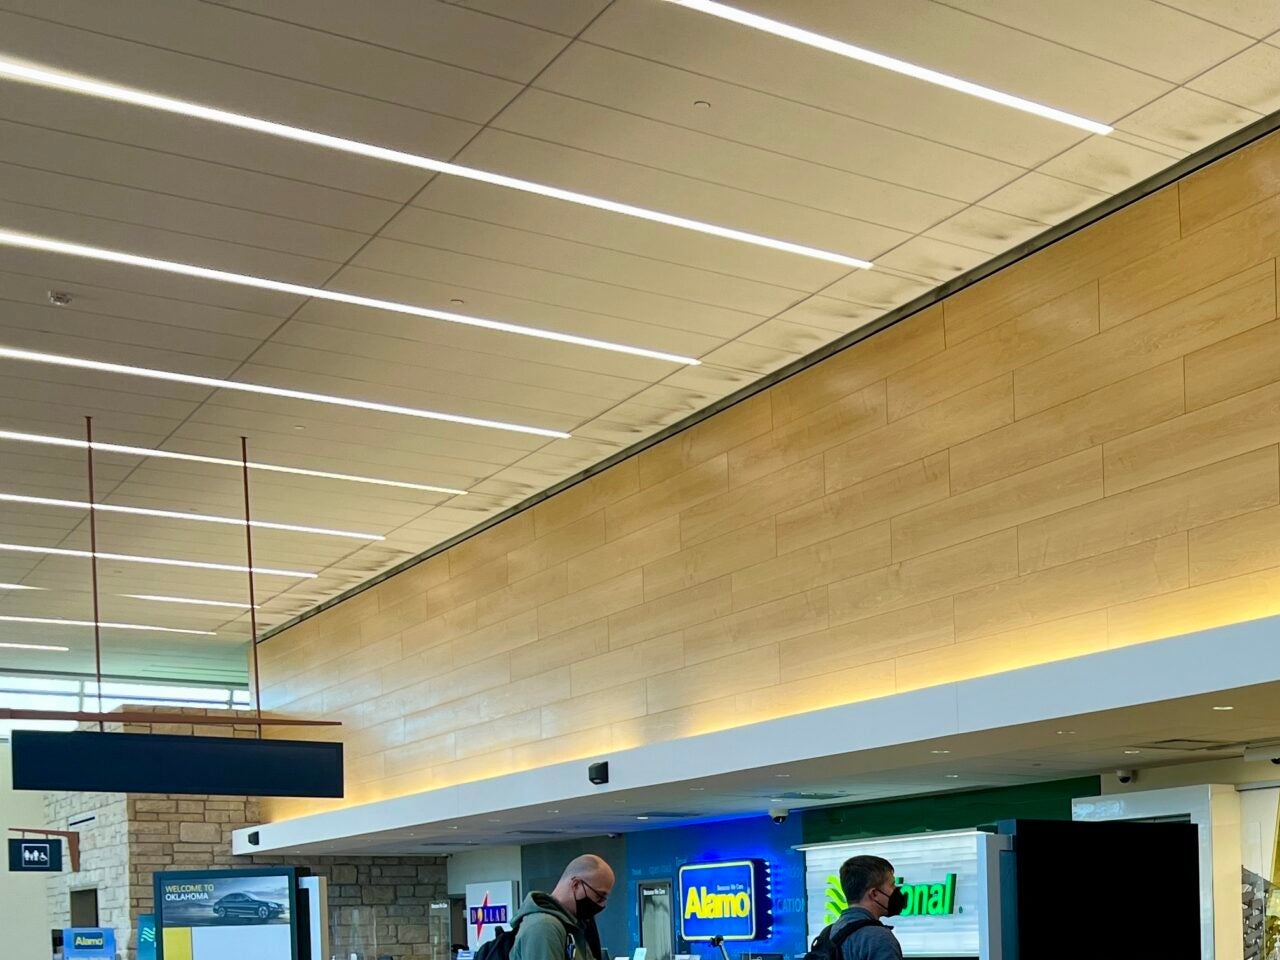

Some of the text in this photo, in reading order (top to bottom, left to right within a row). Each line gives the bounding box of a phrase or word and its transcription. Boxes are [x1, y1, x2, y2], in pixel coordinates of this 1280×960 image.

[165, 883, 214, 893] WELCOME TO
[165, 893, 209, 901] OKLAHOMA
[896, 873, 957, 917] onal
[684, 886, 750, 919] Alamo
[471, 907, 506, 923] DOLLAR
[75, 936, 103, 946] Alamo
